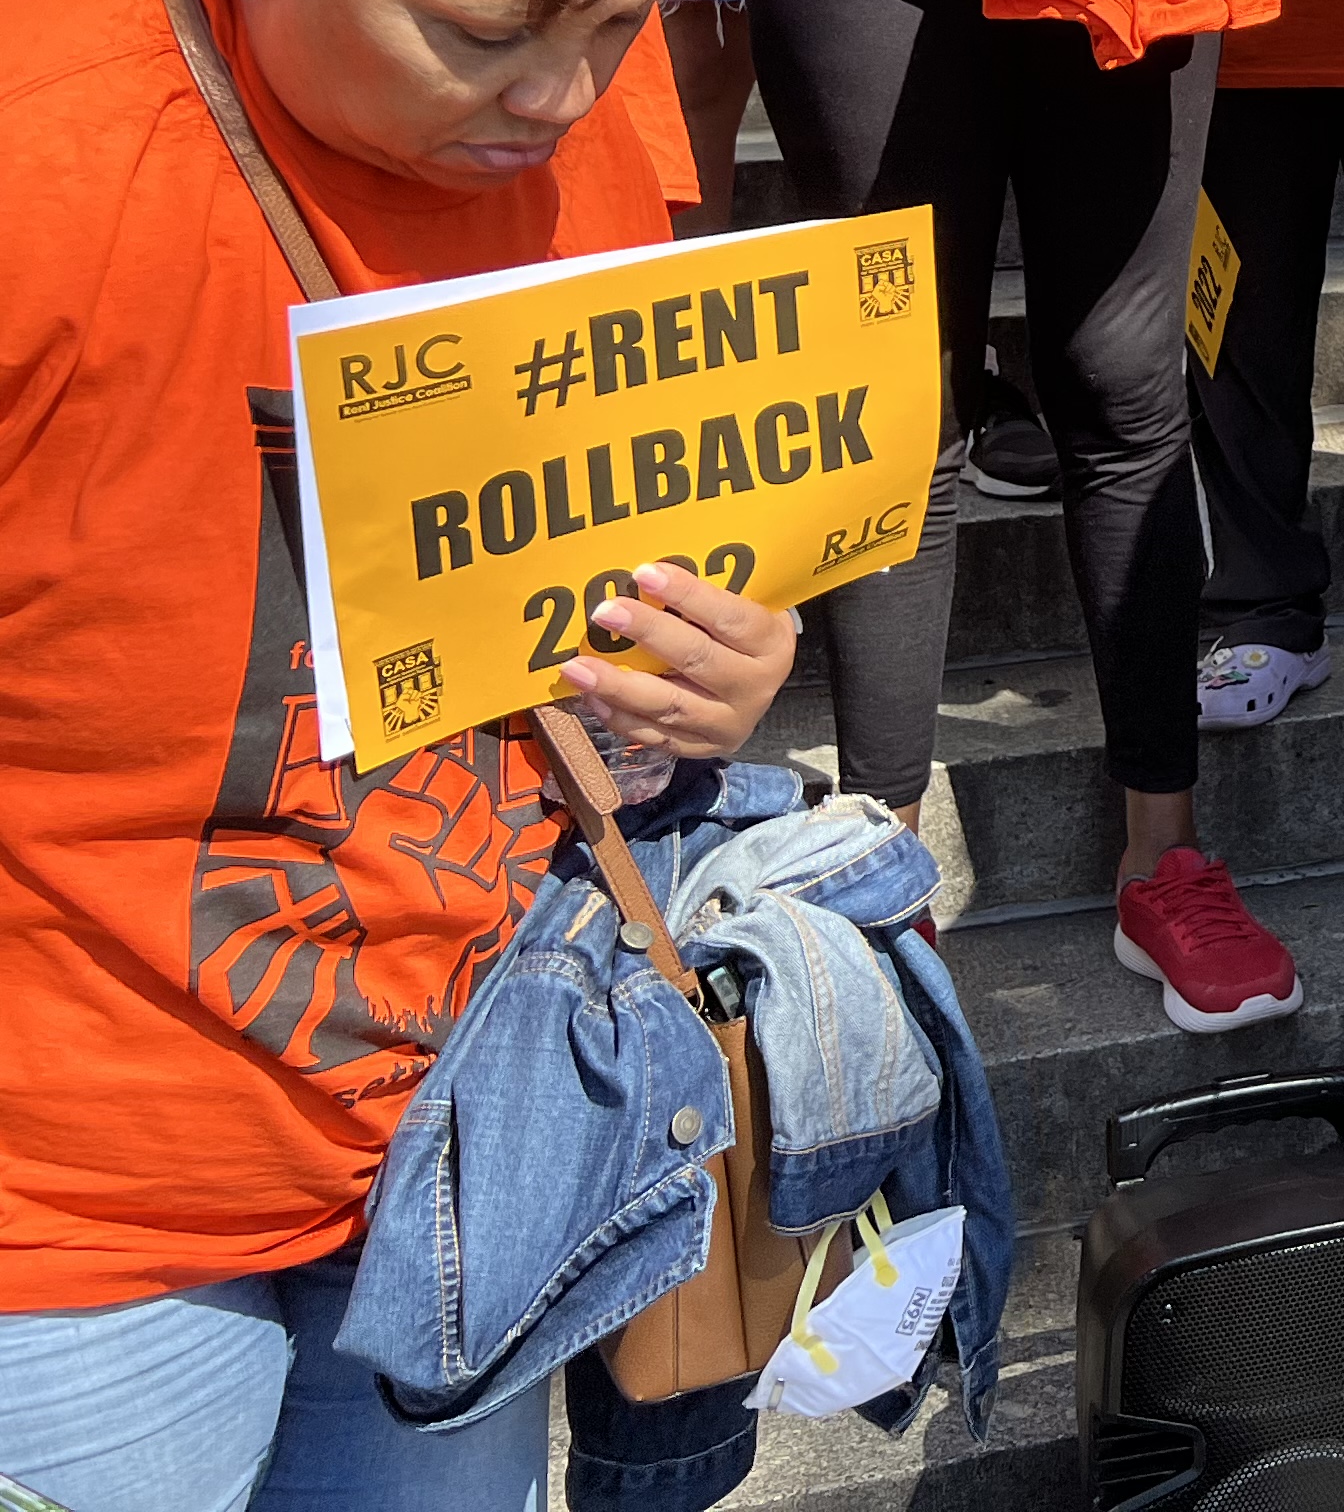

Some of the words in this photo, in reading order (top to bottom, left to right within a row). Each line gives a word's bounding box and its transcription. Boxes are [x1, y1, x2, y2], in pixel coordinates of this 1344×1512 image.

[860, 248, 904, 266] CASA
[340, 333, 466, 400] RJC
[514, 271, 810, 417] #RENT
[342, 401, 371, 417] Rent
[372, 393, 414, 411] Justice
[415, 380, 468, 400] Coalition
[410, 385, 873, 580] ROLLBACK
[821, 501, 912, 563] RJC
[381, 651, 429, 678] CASA
[901, 1292, 928, 1331] N95
